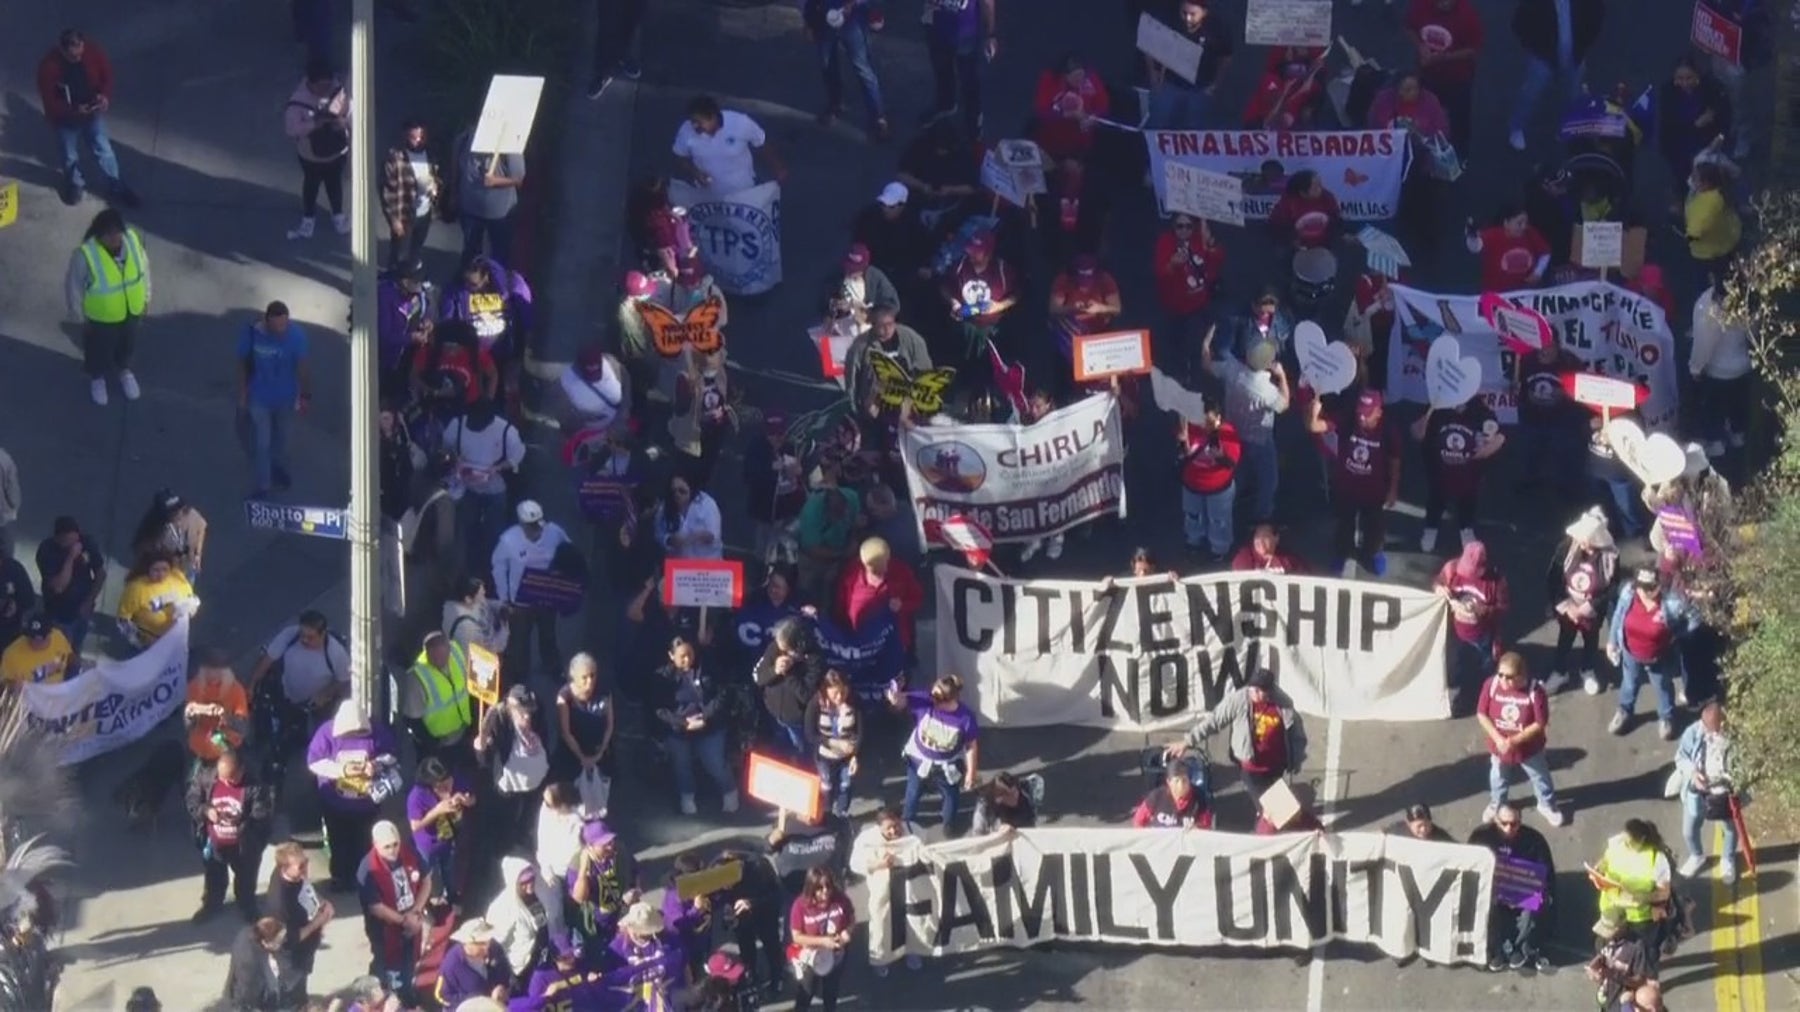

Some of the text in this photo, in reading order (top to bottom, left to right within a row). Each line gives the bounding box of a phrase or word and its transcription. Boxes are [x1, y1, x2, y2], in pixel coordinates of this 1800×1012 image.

[1157, 132, 1393, 157] FIN A LAS REDADAS
[704, 224, 760, 260] TPS
[1564, 317, 1592, 349] EL
[997, 419, 1105, 469] CHIRLA
[251, 503, 303, 523] Shatto
[996, 506, 1036, 532] San
[1038, 471, 1122, 528] Fernando
[953, 578, 1402, 655] CITIZENSHIP
[889, 852, 1197, 953] FAMILY
[1213, 852, 1481, 957] UNITY!
